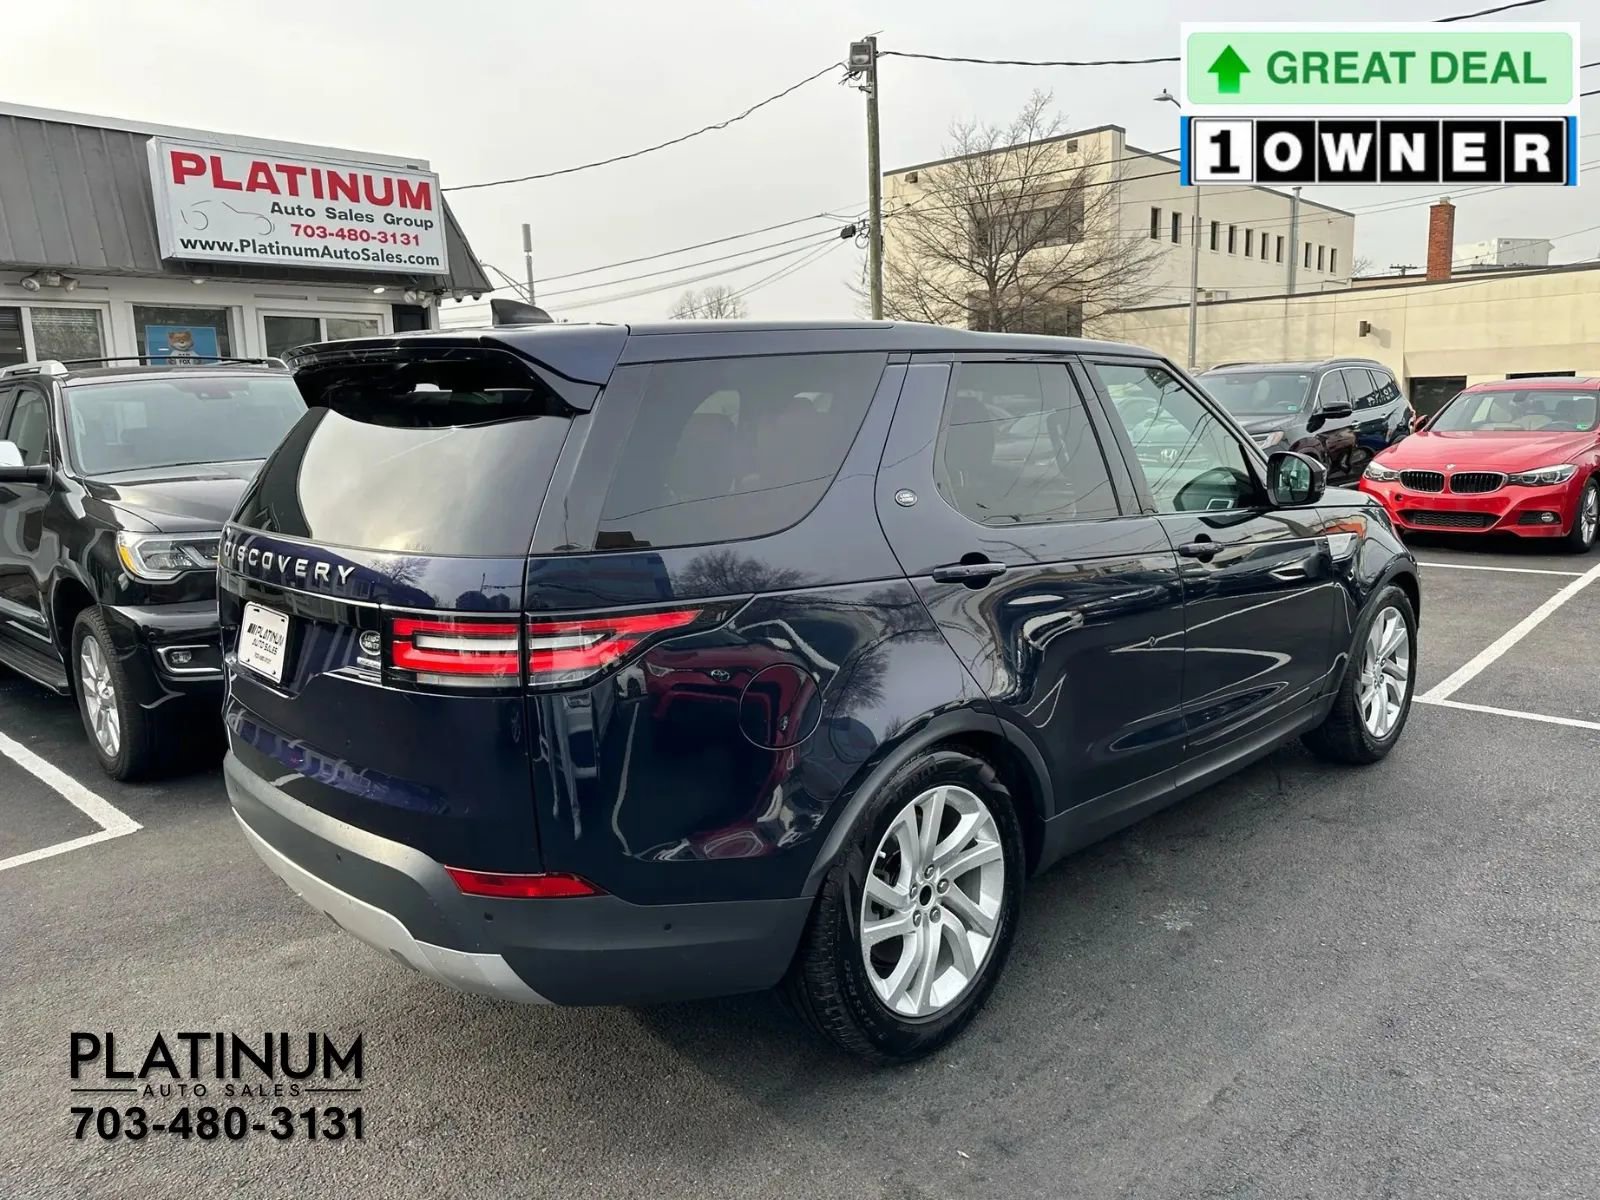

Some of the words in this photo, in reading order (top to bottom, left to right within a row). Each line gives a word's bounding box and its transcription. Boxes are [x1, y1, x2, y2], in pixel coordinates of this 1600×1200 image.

[170, 150, 433, 211] PLATINUM
[270, 201, 316, 218] Auto
[325, 207, 375, 223] Sales
[383, 212, 434, 231] Group
[290, 223, 420, 247] 703-480-3131
[180, 237, 440, 266] www.PlatinumAutoSales.com
[224, 541, 355, 584] DISCOVERY
